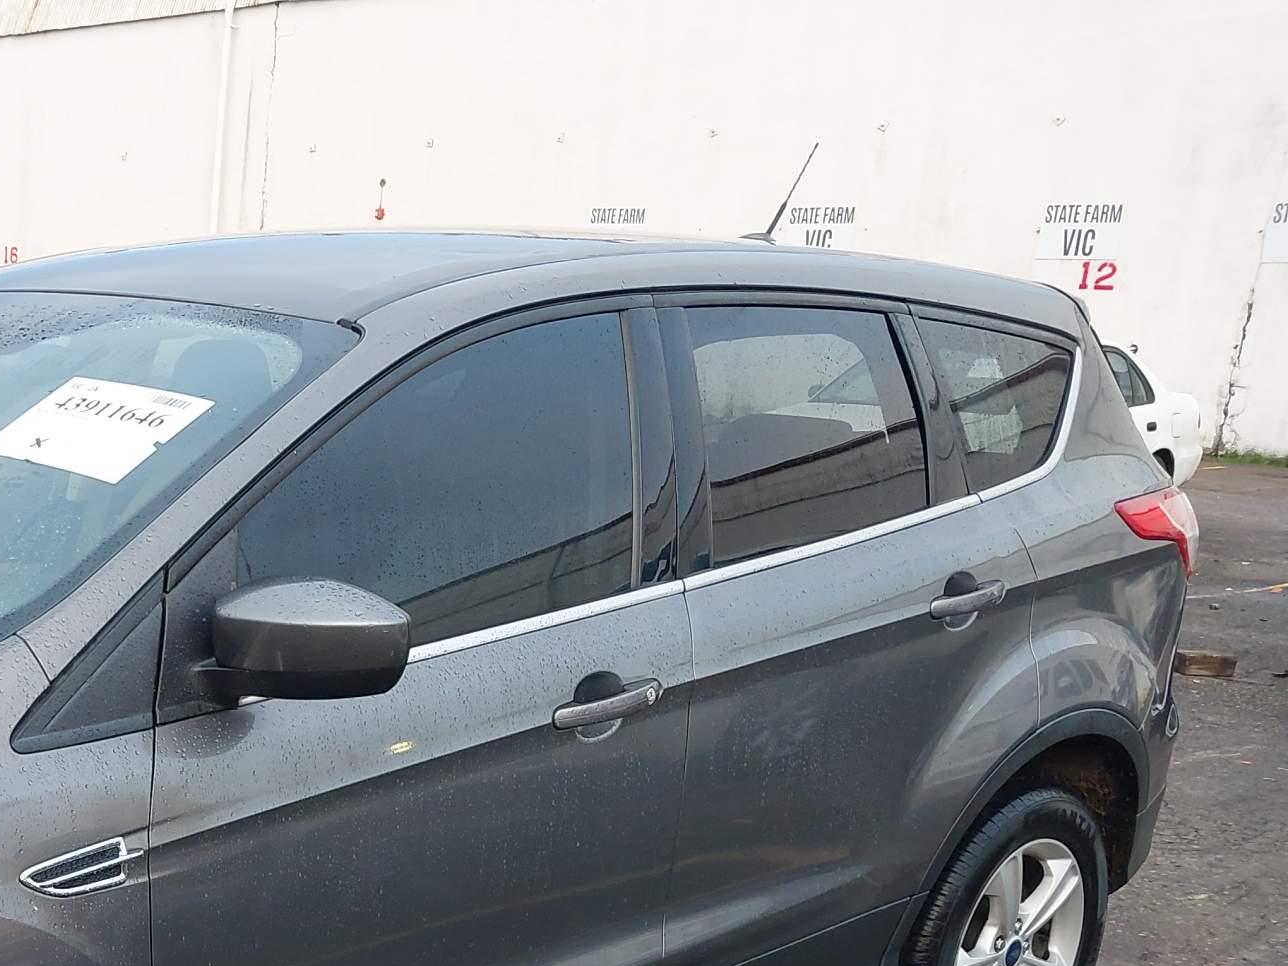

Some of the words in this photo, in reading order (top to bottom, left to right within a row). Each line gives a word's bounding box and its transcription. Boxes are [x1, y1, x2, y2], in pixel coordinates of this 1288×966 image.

[590, 207, 617, 225] STATE
[618, 208, 646, 225] FARM
[790, 207, 820, 225] STATE
[823, 206, 855, 225] FARM
[1045, 204, 1082, 224] STATE
[1084, 204, 1123, 224] FARM
[805, 229, 833, 248] VIC
[1063, 228, 1096, 257] VIC
[3, 246, 19, 265] 16
[1078, 261, 1117, 291] 12
[55, 396, 171, 429] 43911646
